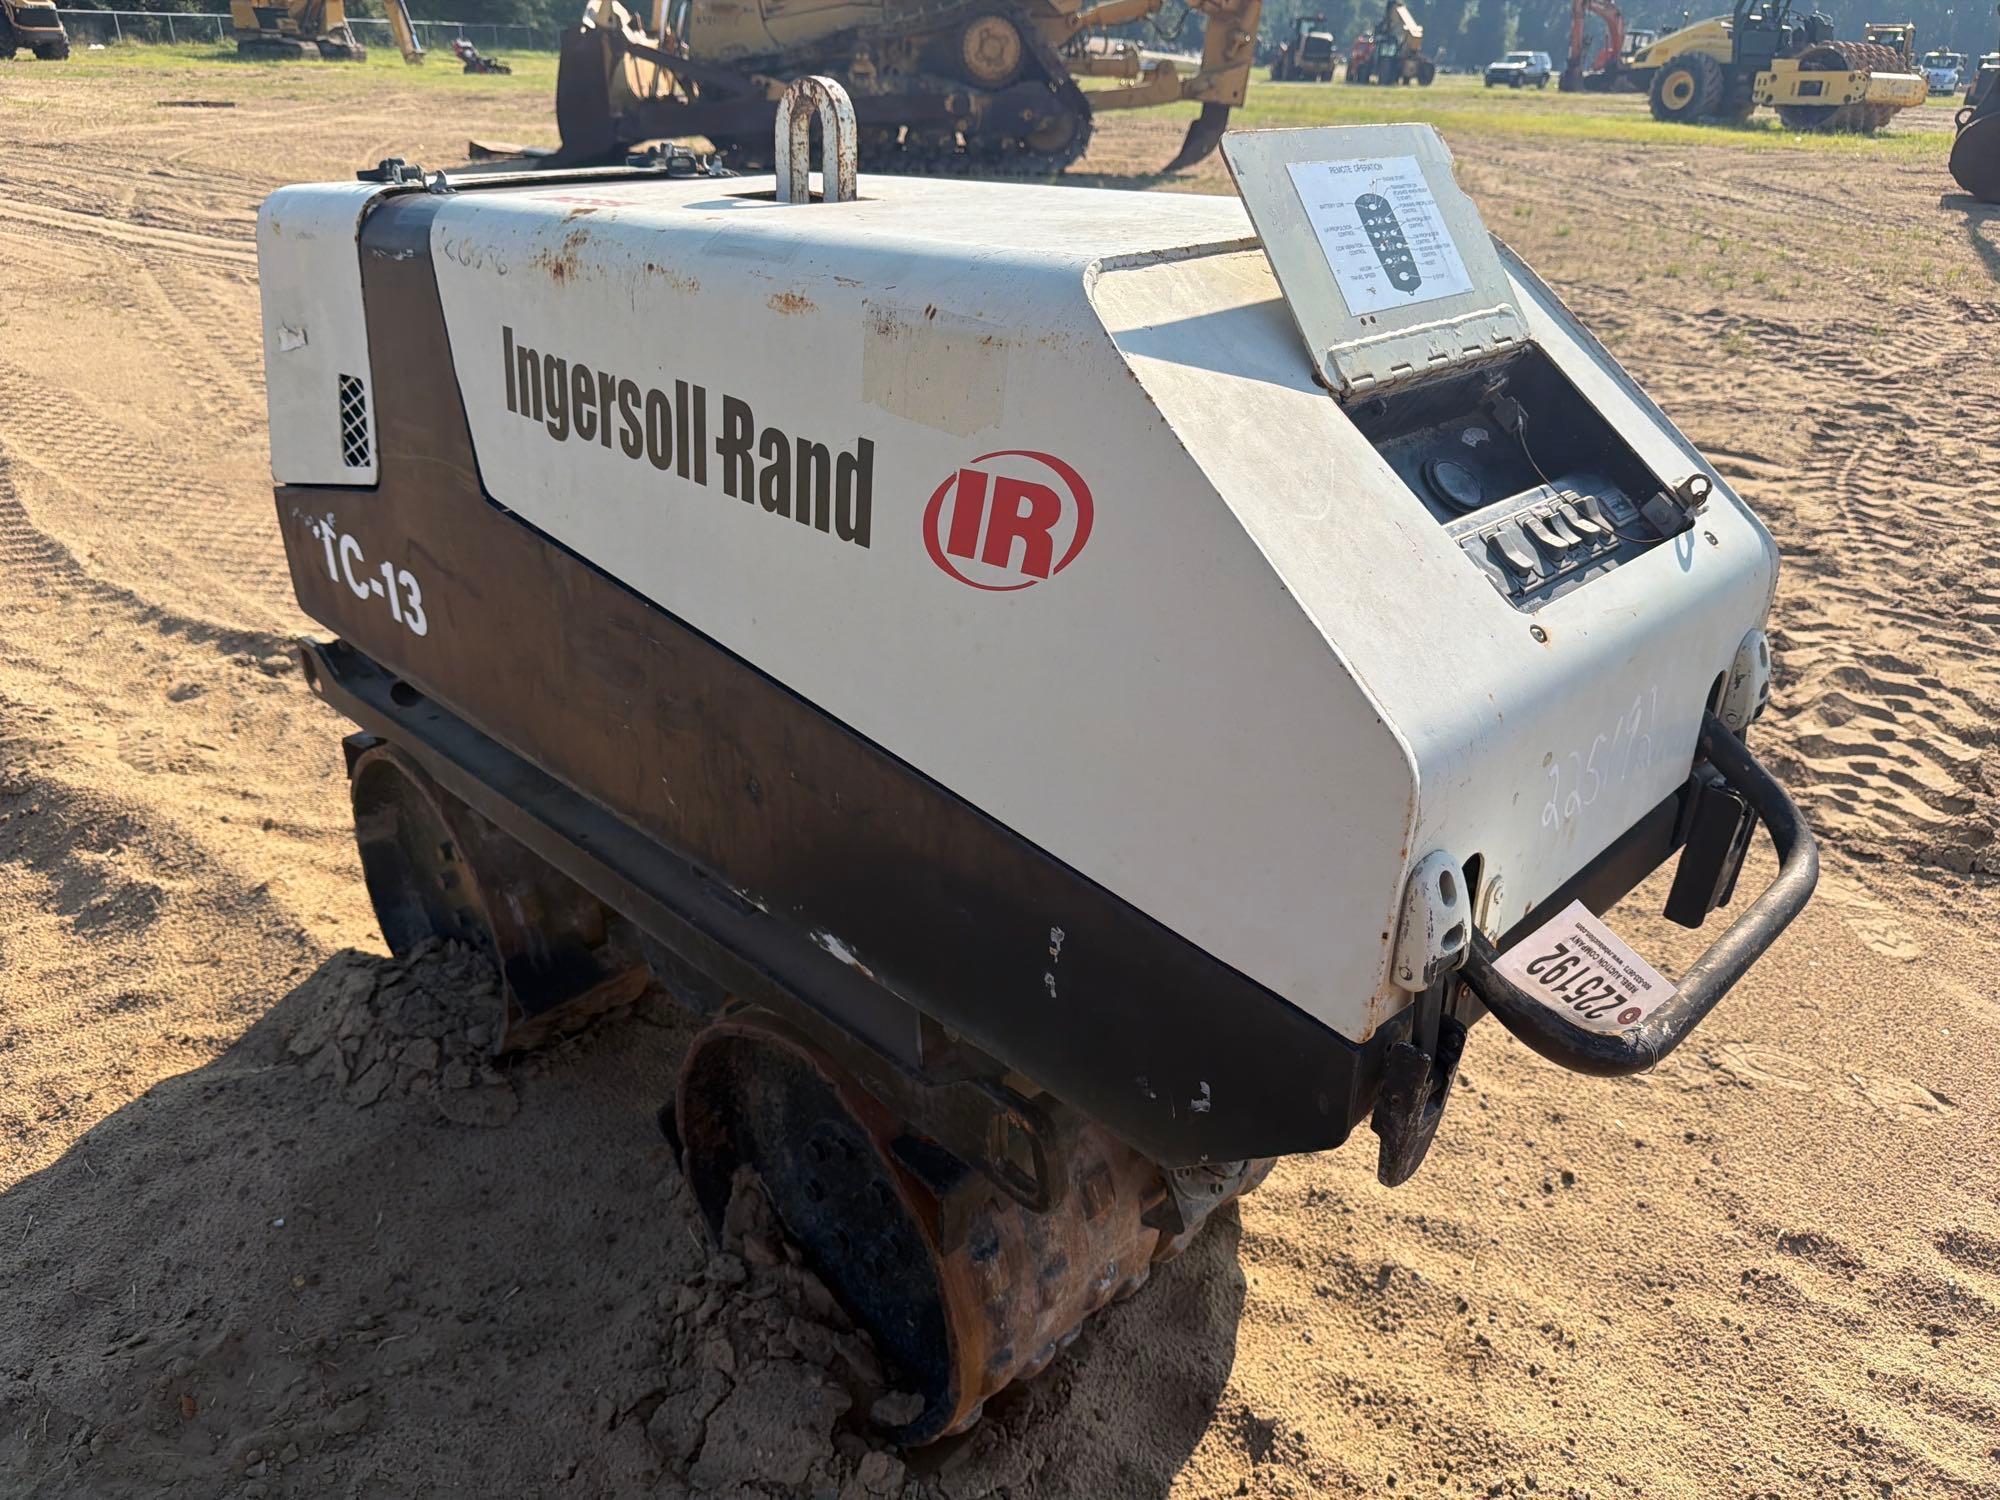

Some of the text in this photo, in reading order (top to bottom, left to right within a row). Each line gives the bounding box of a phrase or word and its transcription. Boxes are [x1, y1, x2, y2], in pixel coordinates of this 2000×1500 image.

[502, 326, 874, 549] Ingersoll Rand
[313, 519, 427, 636] TC-13
[947, 468, 1062, 580] IR
[1526, 942, 1628, 1019] 225192
[1570, 933, 1638, 994] REBEL AUCTION COMPANY
